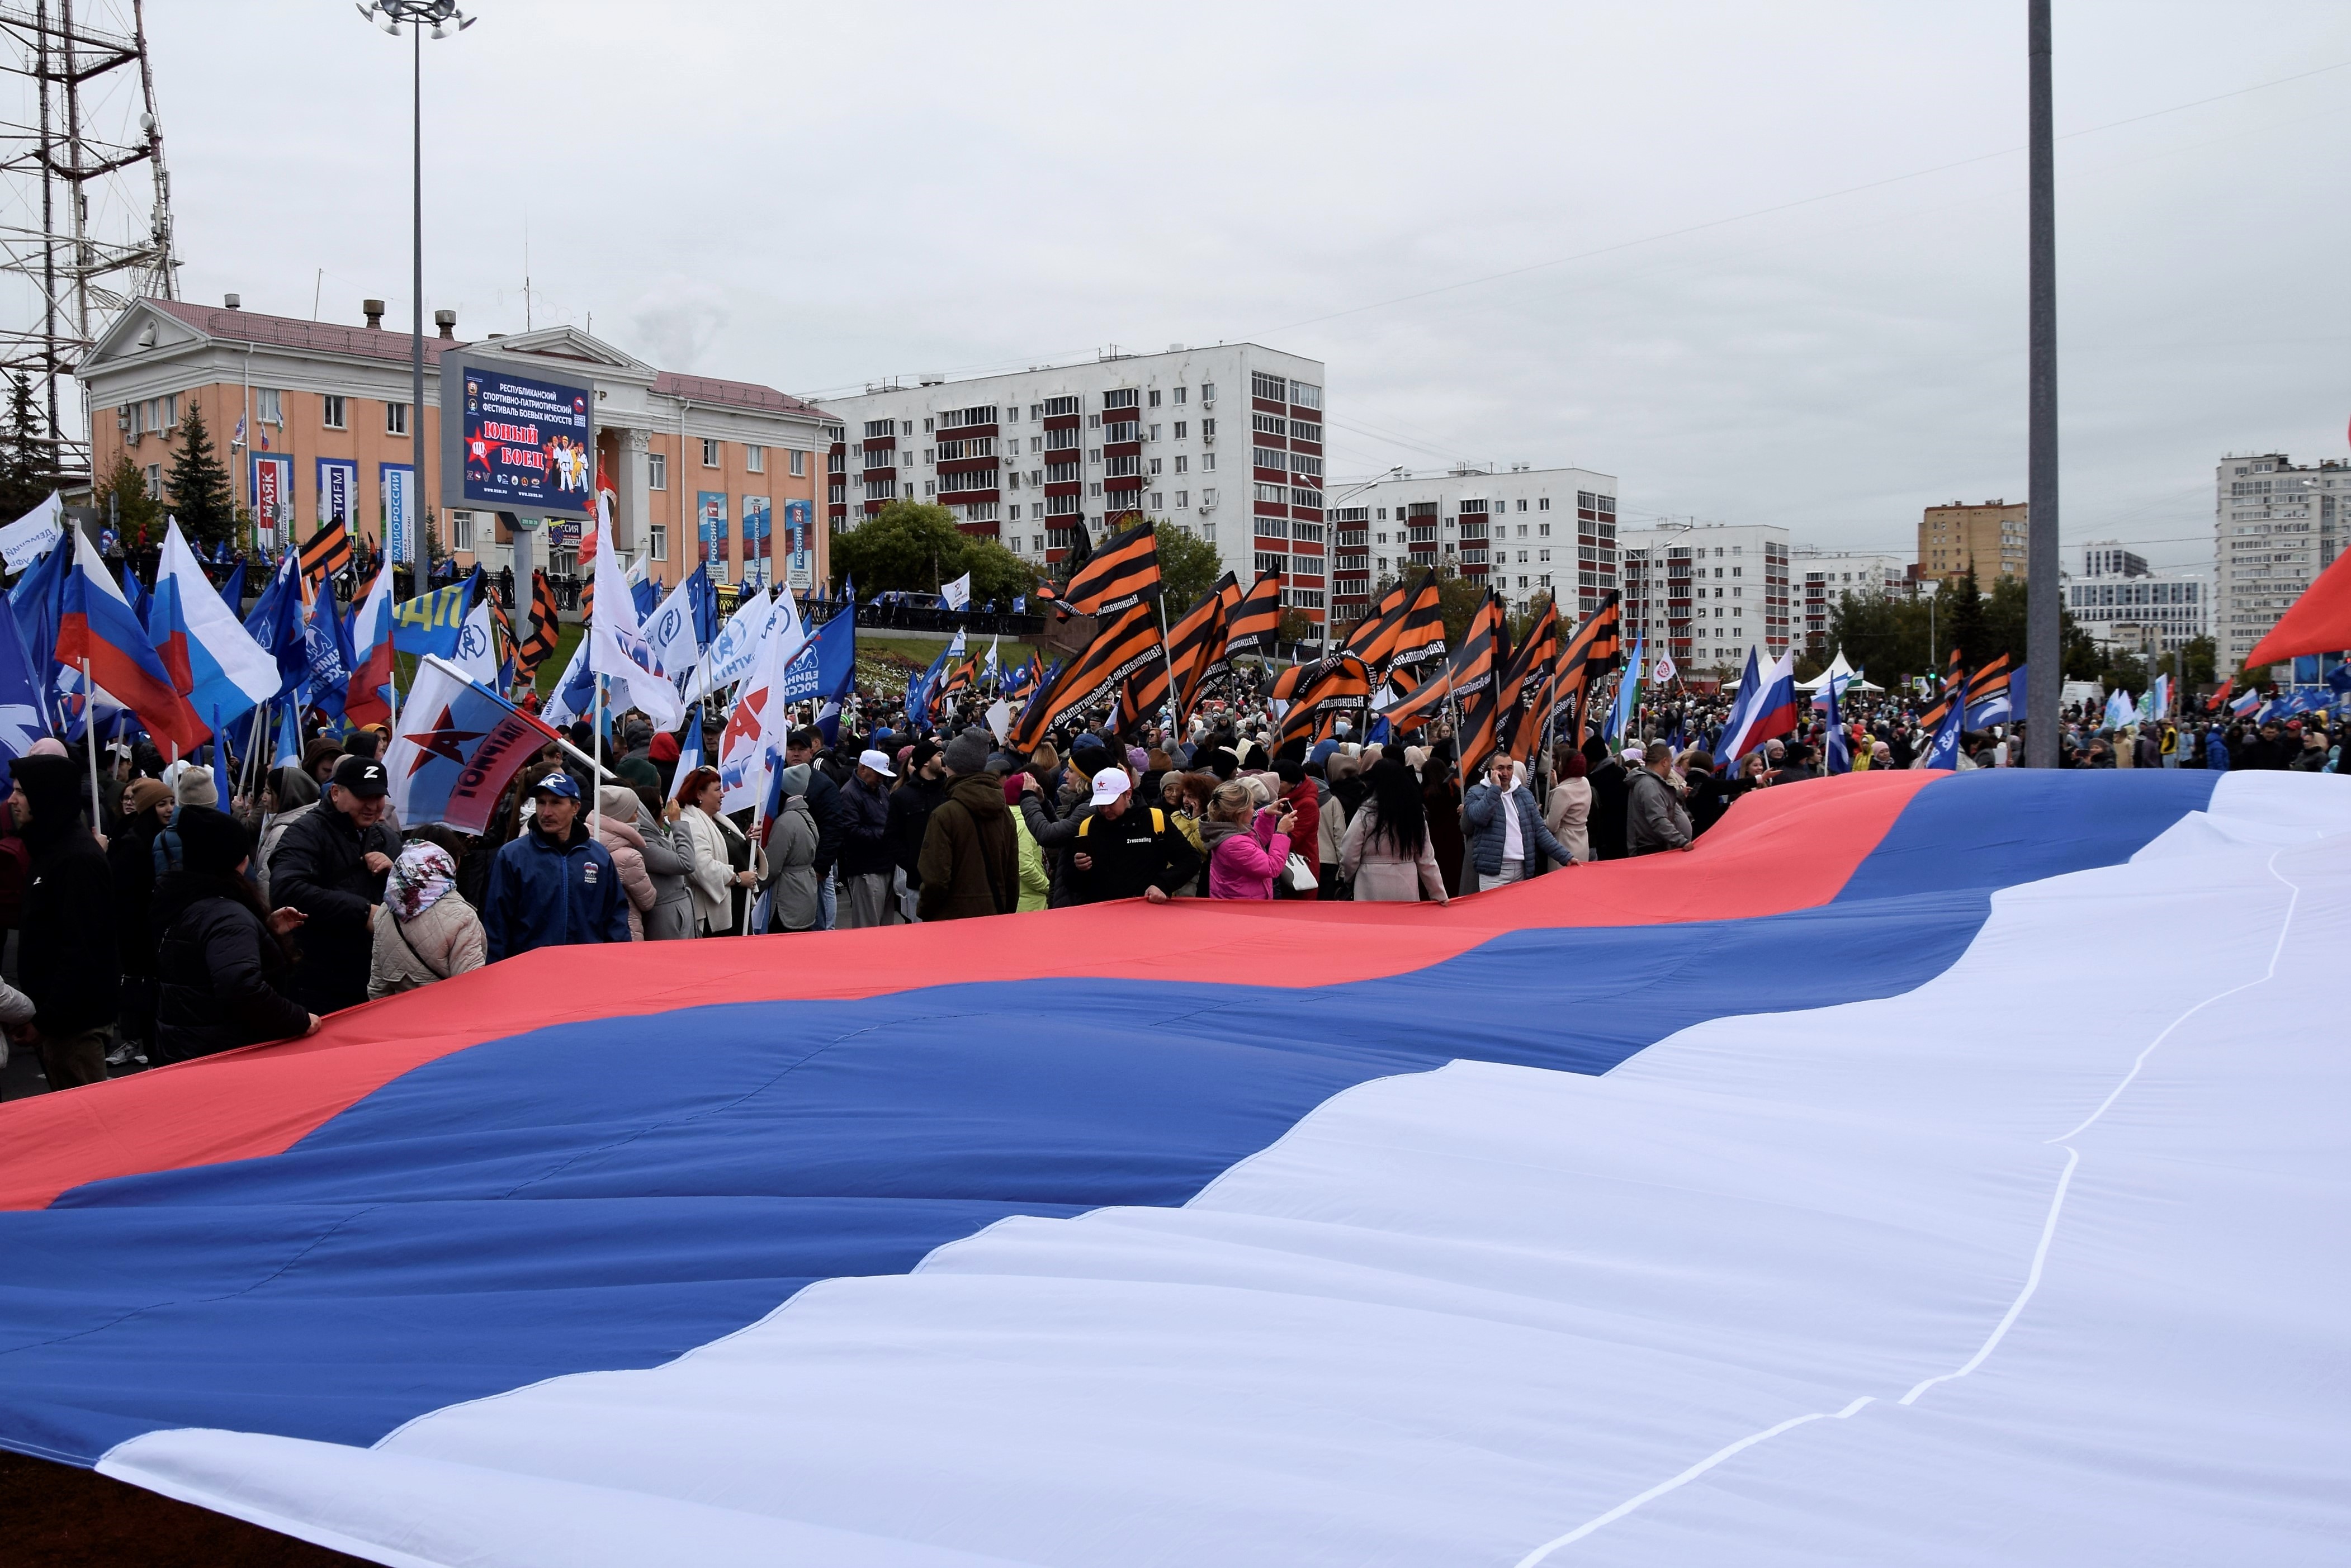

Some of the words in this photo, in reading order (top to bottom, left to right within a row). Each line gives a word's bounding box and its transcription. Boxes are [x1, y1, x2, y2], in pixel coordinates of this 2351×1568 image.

[483, 392, 572, 414] СПОРТИВНО-ПАТРИОТИЧЕСКИЙ
[500, 383, 556, 401] РЕСПУБЛИКАНСКИЙ
[483, 403, 519, 416] ФЕСТИВАЛЬ
[519, 409, 543, 421] БОЕВЫХ
[544, 414, 572, 425] ИСКУССТВ
[484, 421, 538, 445] ЮНЫЙ
[502, 447, 544, 471] БОЕЦ
[263, 472, 277, 518] МАЯК
[392, 474, 402, 561] РАДИОРОССИИ
[796, 510, 802, 522] 24
[551, 524, 579, 533] РССИЯ
[363, 766, 379, 779] Z
